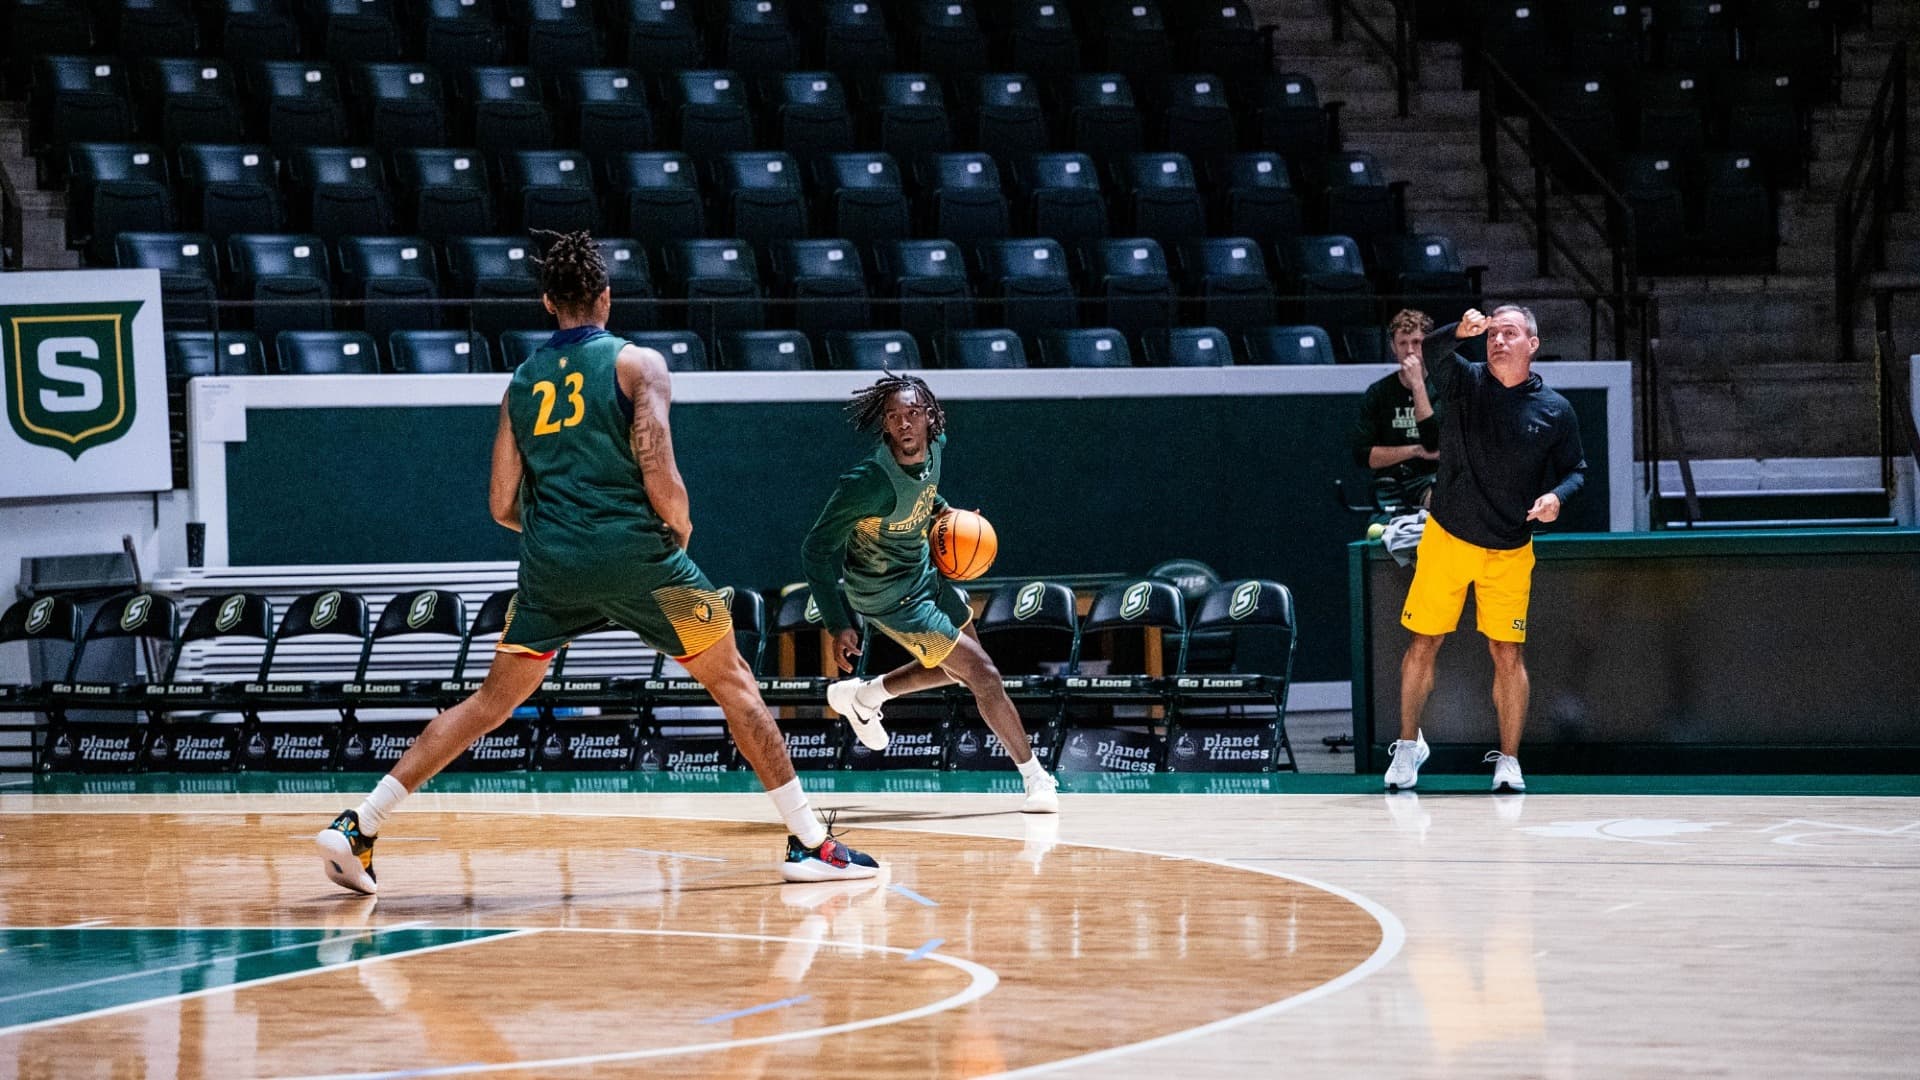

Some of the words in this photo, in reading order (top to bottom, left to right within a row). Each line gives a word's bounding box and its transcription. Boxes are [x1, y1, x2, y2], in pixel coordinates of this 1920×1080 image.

[37, 336, 103, 412] S
[532, 372, 585, 436] 23
[79, 735, 130, 750] planet
[174, 735, 225, 750] planet
[272, 734, 324, 748] planet
[370, 734, 416, 749] plane
[568, 734, 620, 749] planet
[785, 733, 826, 745] lanet
[890, 732, 932, 744] lanet
[1203, 734, 1260, 750] planet
[83, 747, 136, 760] fitness
[178, 747, 231, 760] fitness
[276, 745, 330, 759] fitness
[374, 746, 404, 759] fitn
[473, 746, 526, 759] fitness
[573, 746, 628, 759] fitness
[787, 746, 834, 758] itness
[1096, 740, 1150, 759] planet
[1209, 746, 1269, 760] fitness
[667, 751, 719, 766] planet
[1100, 753, 1156, 774] fitness
